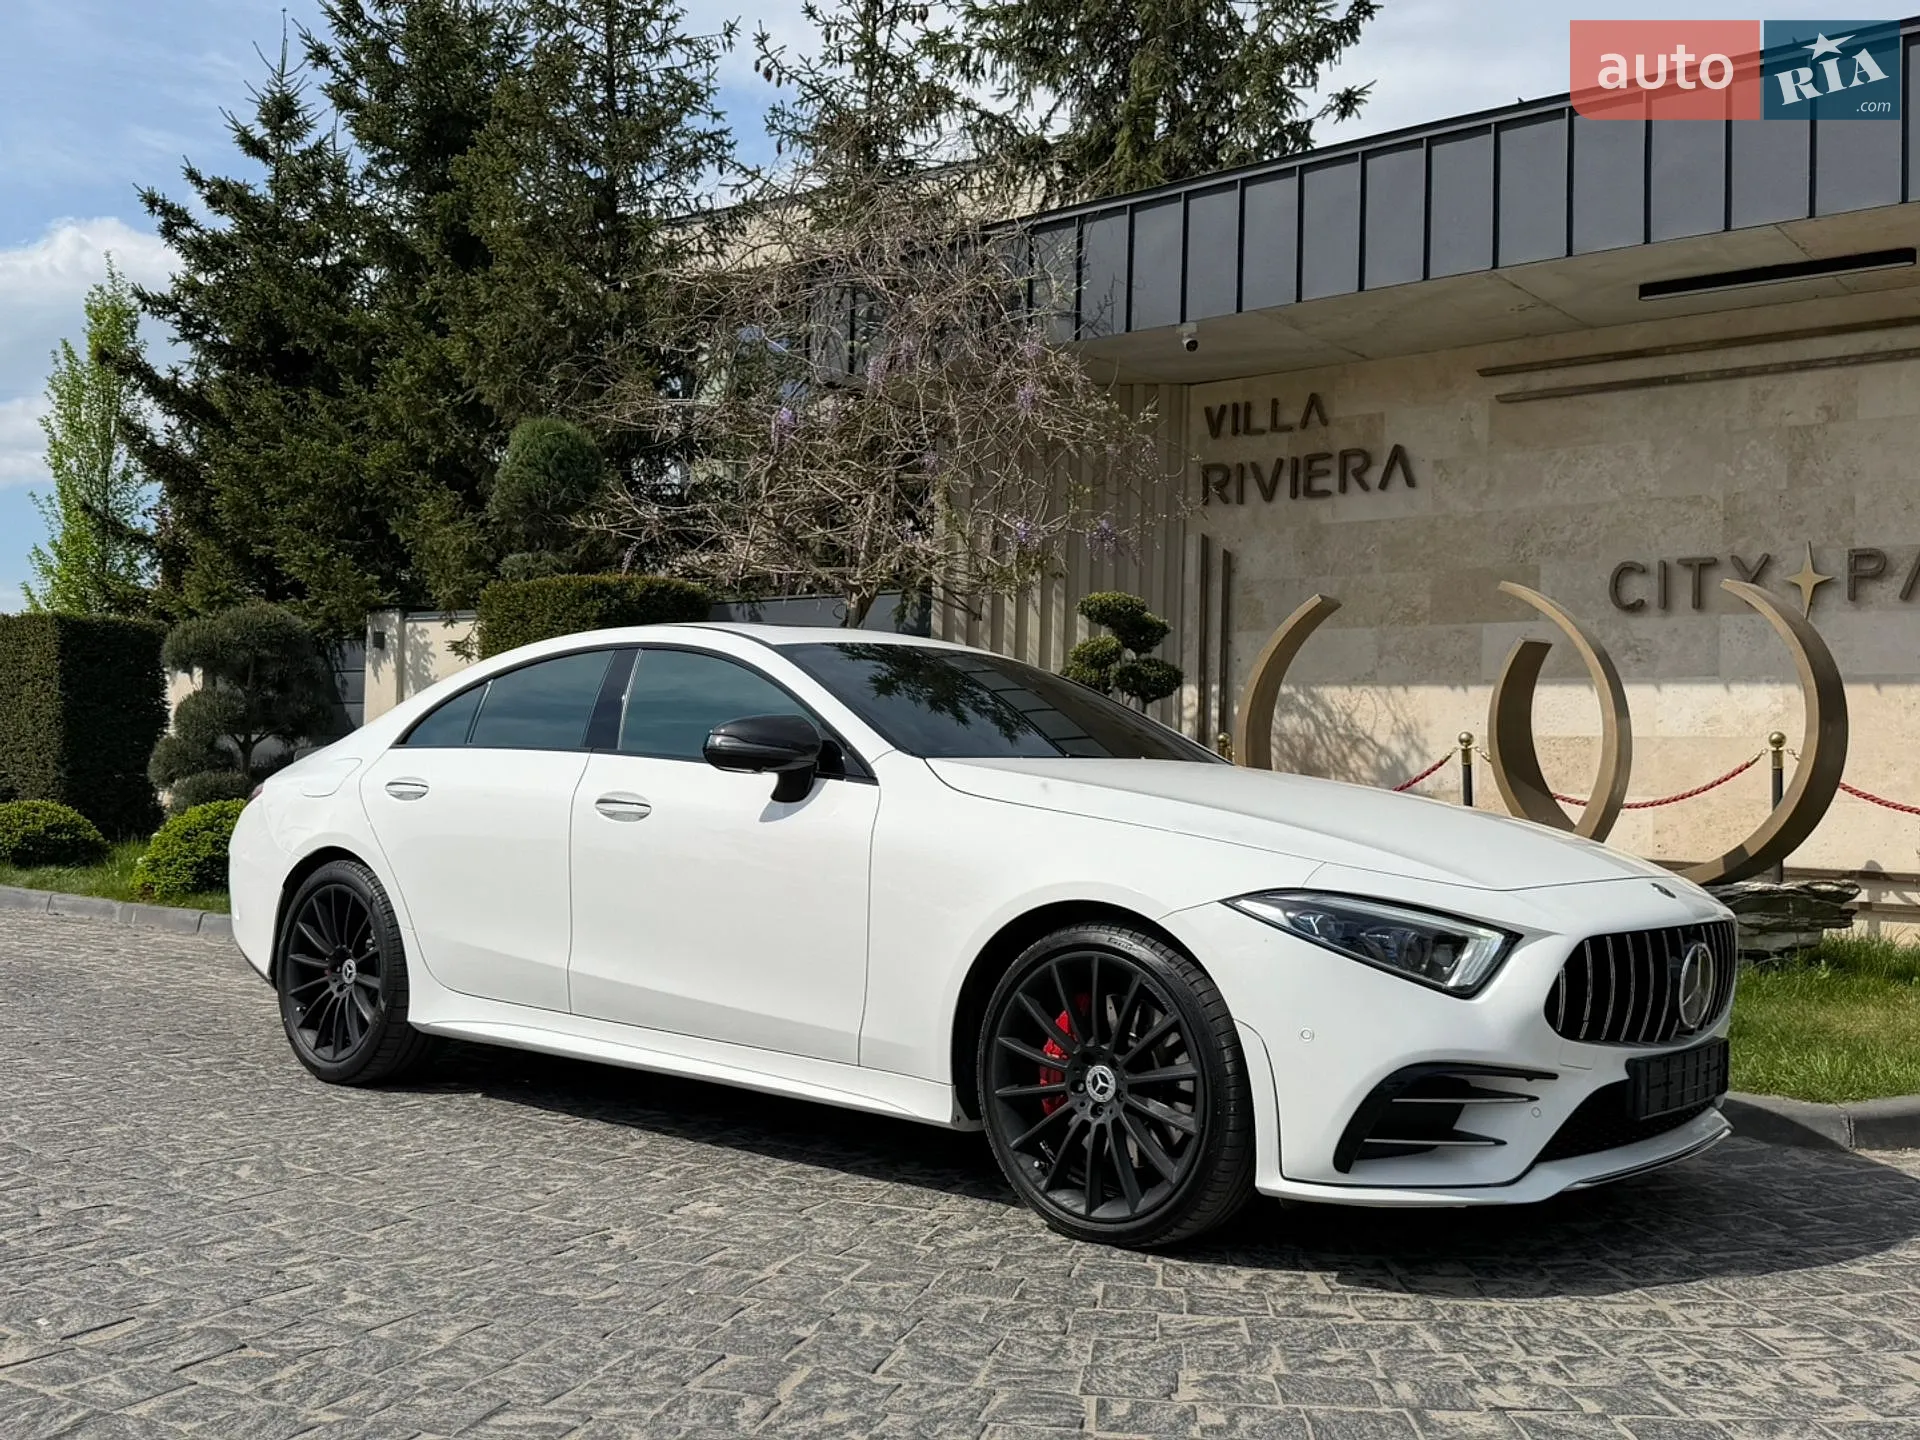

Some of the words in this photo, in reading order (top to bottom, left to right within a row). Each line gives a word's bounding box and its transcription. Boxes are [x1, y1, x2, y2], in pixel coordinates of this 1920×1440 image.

[1204, 392, 1329, 440] VILLA
[1201, 443, 1417, 506] RIVIERA
[1608, 552, 1771, 612] CITY
